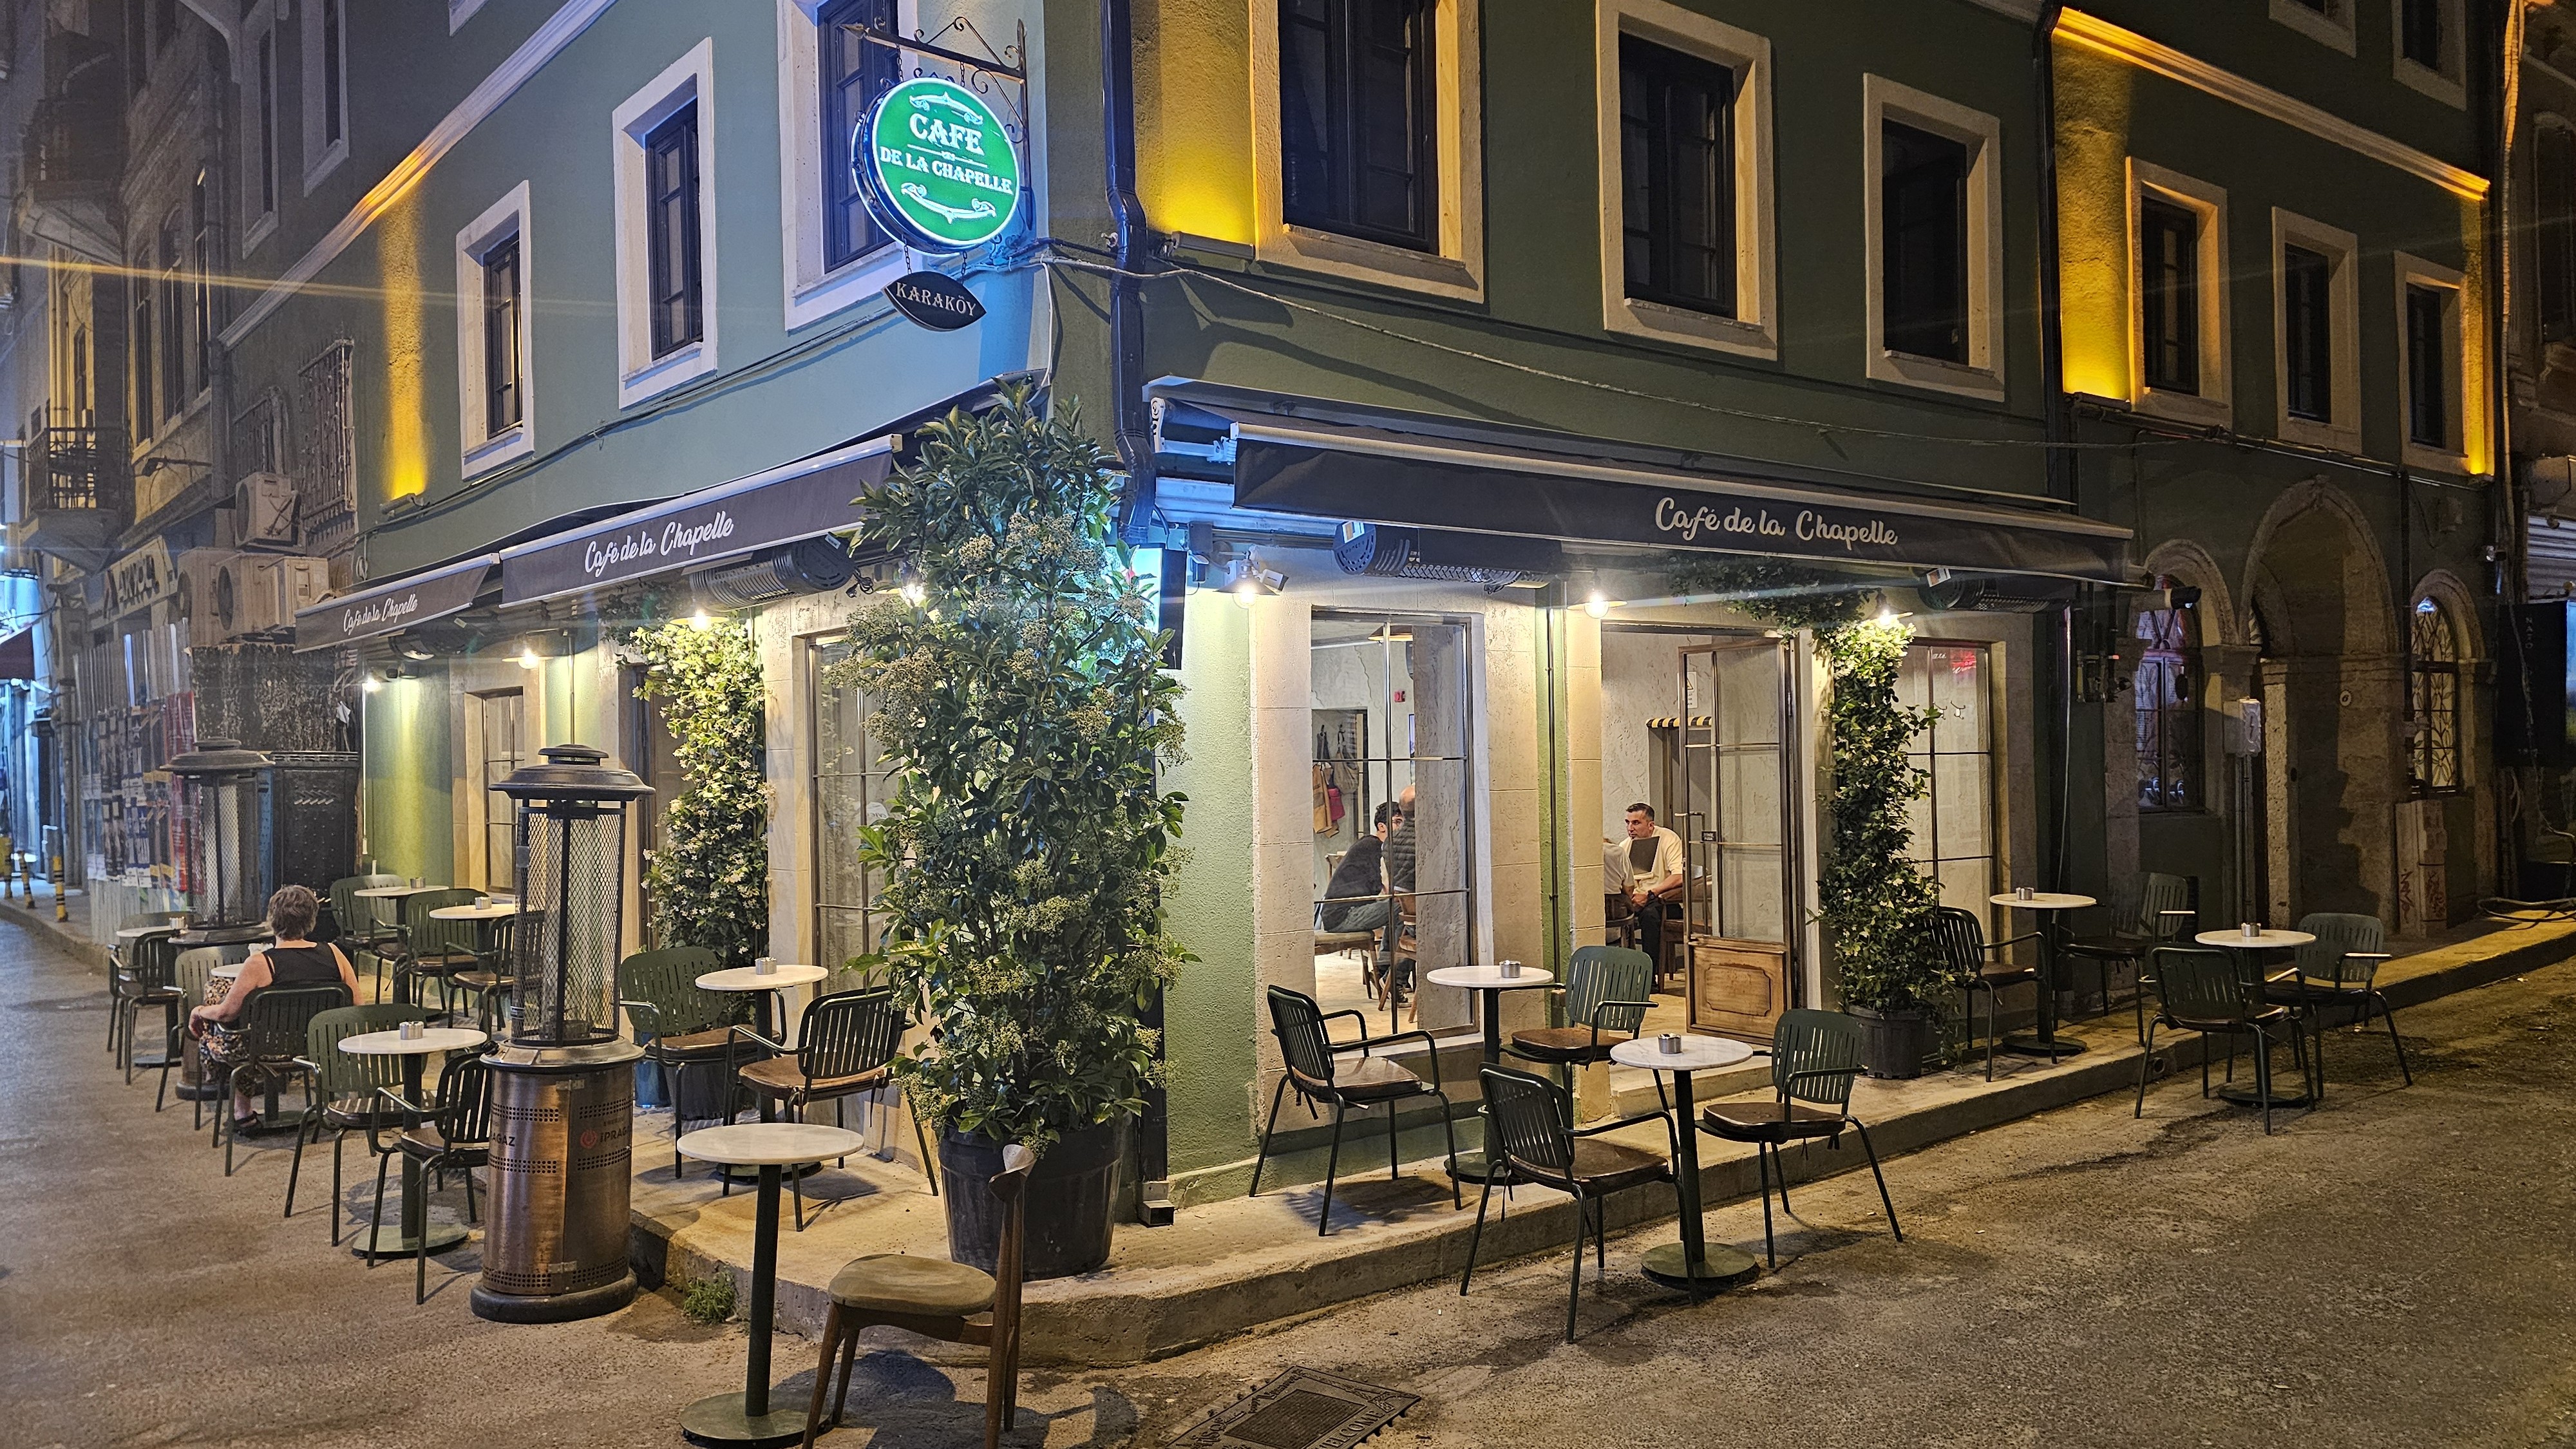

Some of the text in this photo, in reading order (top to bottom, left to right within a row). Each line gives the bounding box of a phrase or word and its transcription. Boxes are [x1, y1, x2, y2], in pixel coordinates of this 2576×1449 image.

[909, 113, 985, 155] CAFE
[880, 146, 1013, 194] DE LA CHAPELLE
[896, 282, 976, 316] KARAKÖY
[585, 511, 734, 578] Café de la Chapelle
[1655, 497, 1898, 551] Café de la Chapelle
[381, 594, 418, 623] Chapelle
[491, 1132, 515, 1146] AGAZ
